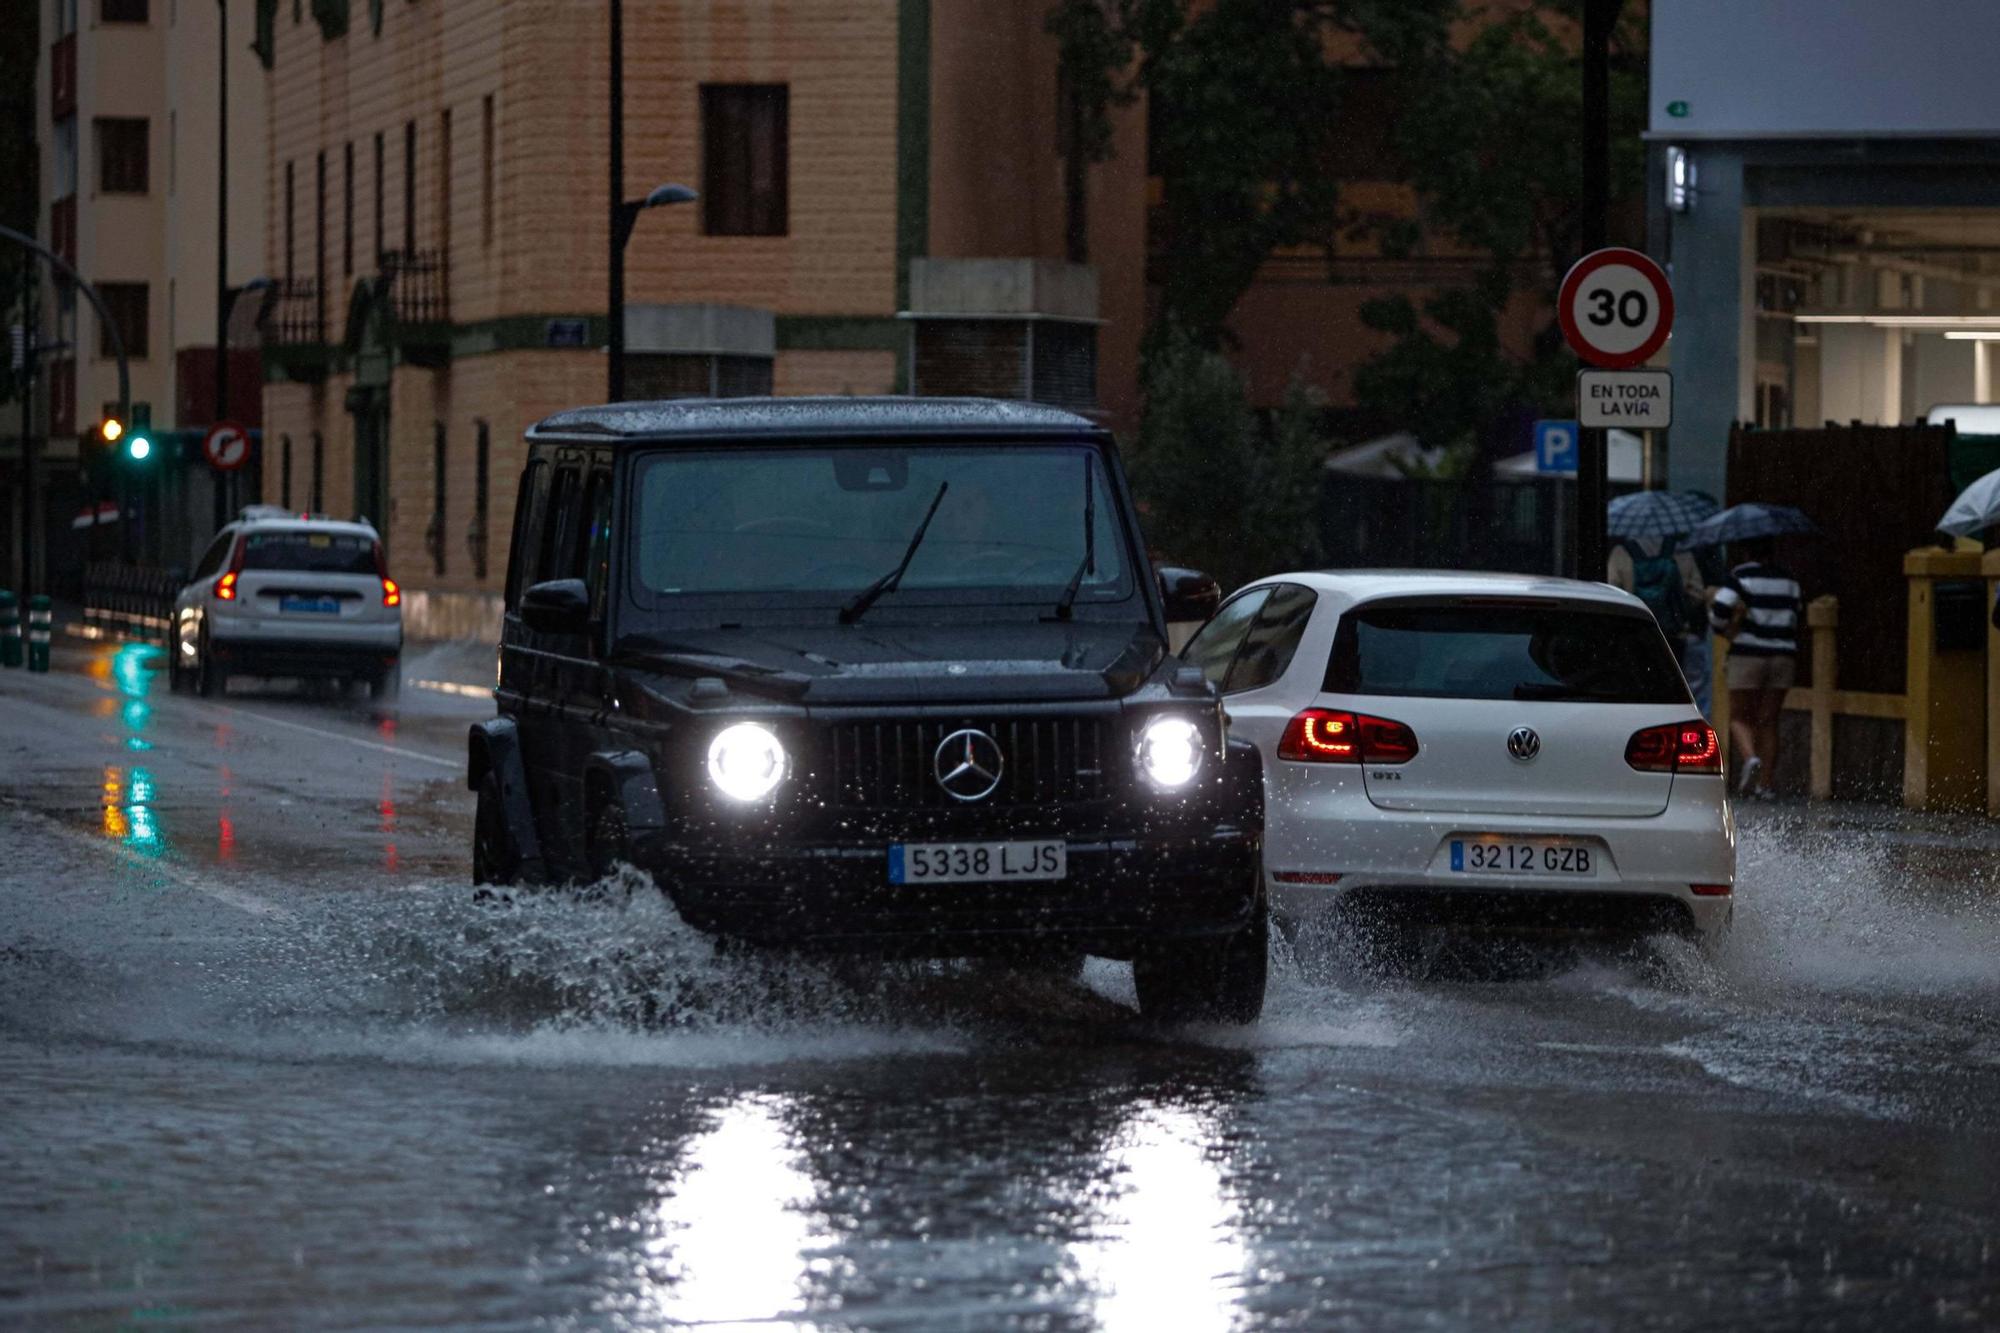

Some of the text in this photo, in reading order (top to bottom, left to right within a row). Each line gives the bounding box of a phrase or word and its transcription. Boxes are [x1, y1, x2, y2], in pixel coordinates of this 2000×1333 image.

[1588, 289, 1647, 327] 30
[1591, 384, 1661, 398] EN TODA
[1601, 402, 1621, 415] LA
[1544, 427, 1570, 464] P
[913, 845, 1058, 877] 5338 LJS
[1470, 844, 1590, 872] 3212 GZB
